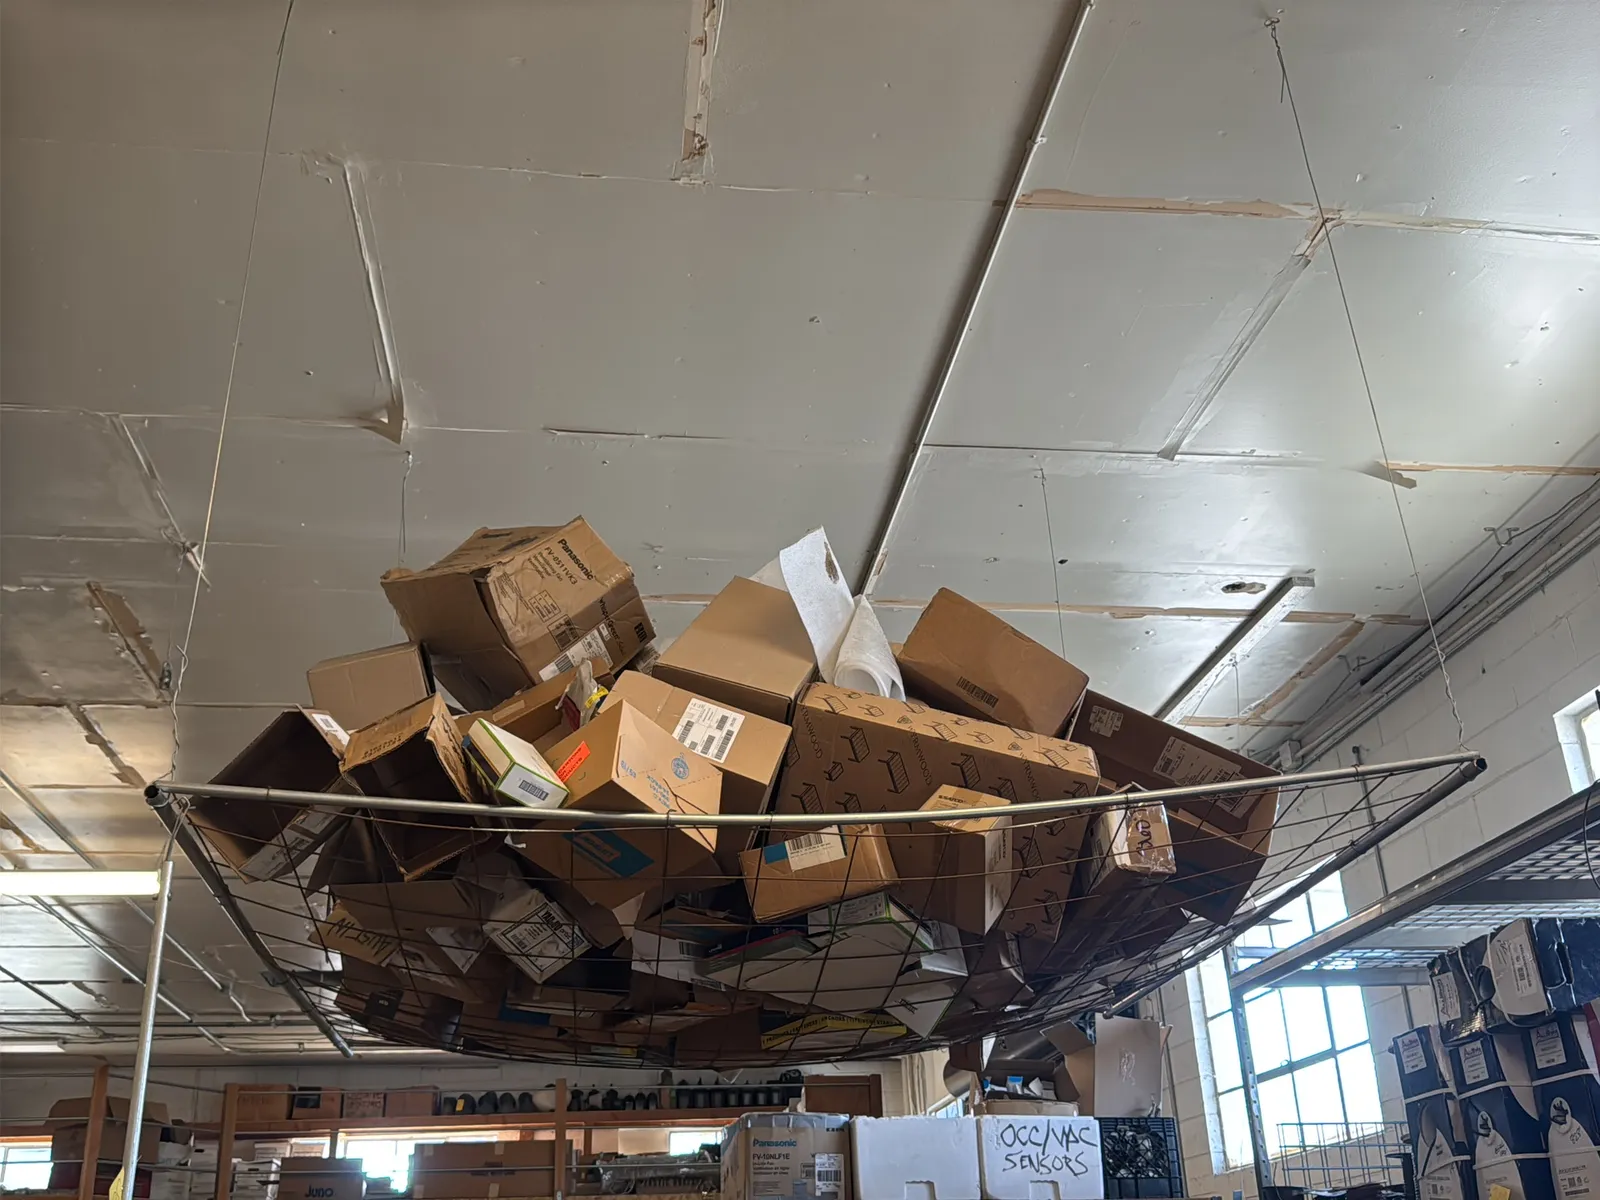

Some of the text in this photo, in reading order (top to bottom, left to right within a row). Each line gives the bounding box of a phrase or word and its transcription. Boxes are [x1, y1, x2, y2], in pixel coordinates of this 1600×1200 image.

[544, 546, 578, 585] FV-0511VK3
[557, 538, 594, 581] Panasonic
[753, 1138, 797, 1147] Panasonic
[1000, 1119, 1098, 1155] OCC/VAC
[1002, 1150, 1089, 1178] SENSORS
[304, 1184, 334, 1198] Juno
